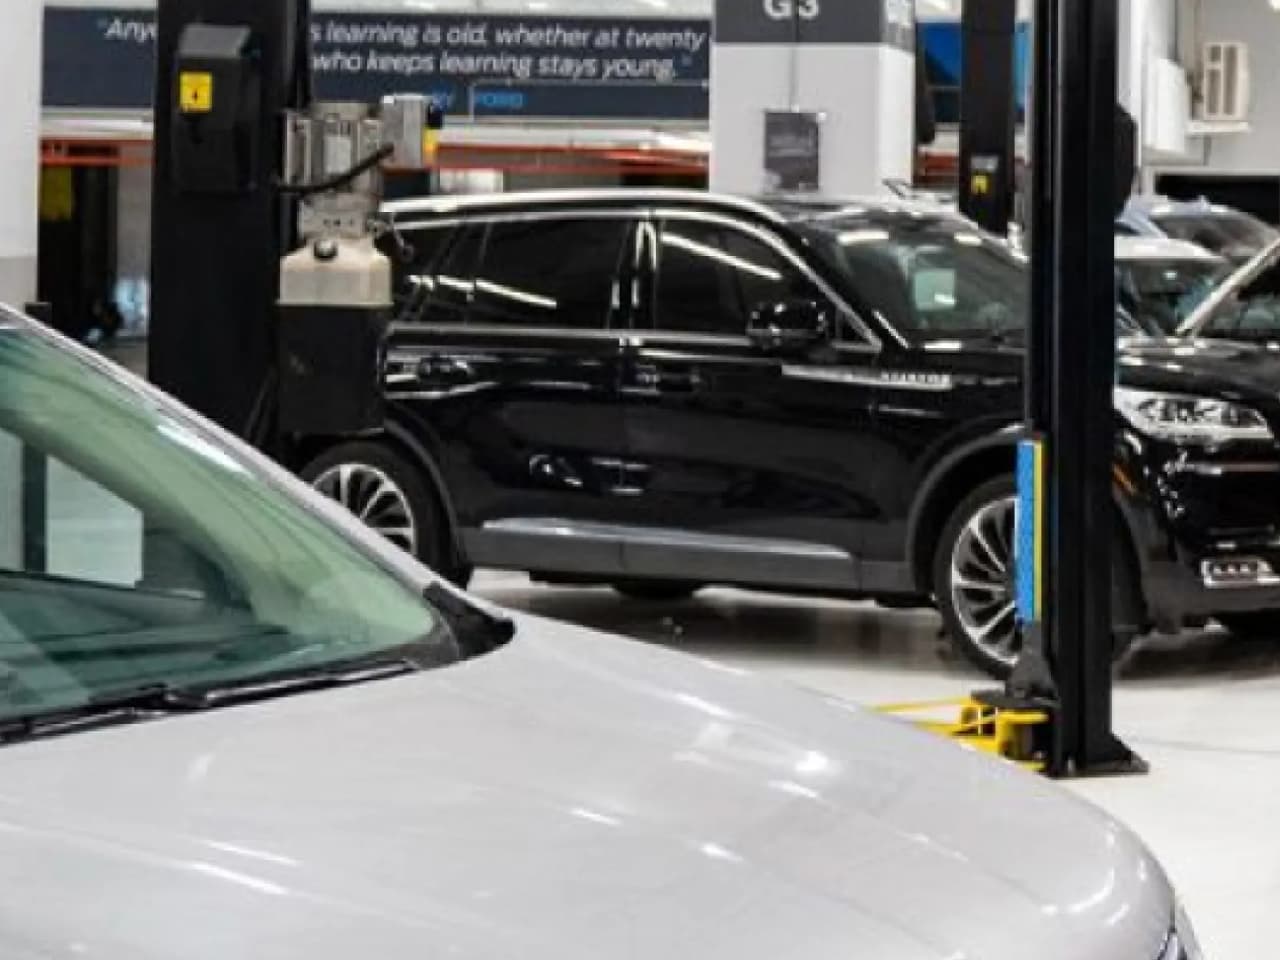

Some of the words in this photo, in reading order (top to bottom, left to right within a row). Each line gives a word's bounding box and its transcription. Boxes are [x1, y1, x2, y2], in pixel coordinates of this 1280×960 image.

[328, 20, 419, 48] learning
[423, 23, 440, 44] is
[496, 22, 591, 49] whether
[595, 26, 620, 49] at
[627, 26, 707, 53] twenty
[313, 49, 361, 71] who
[366, 49, 434, 76] keeps
[440, 51, 532, 80] learning
[539, 54, 598, 80] stays
